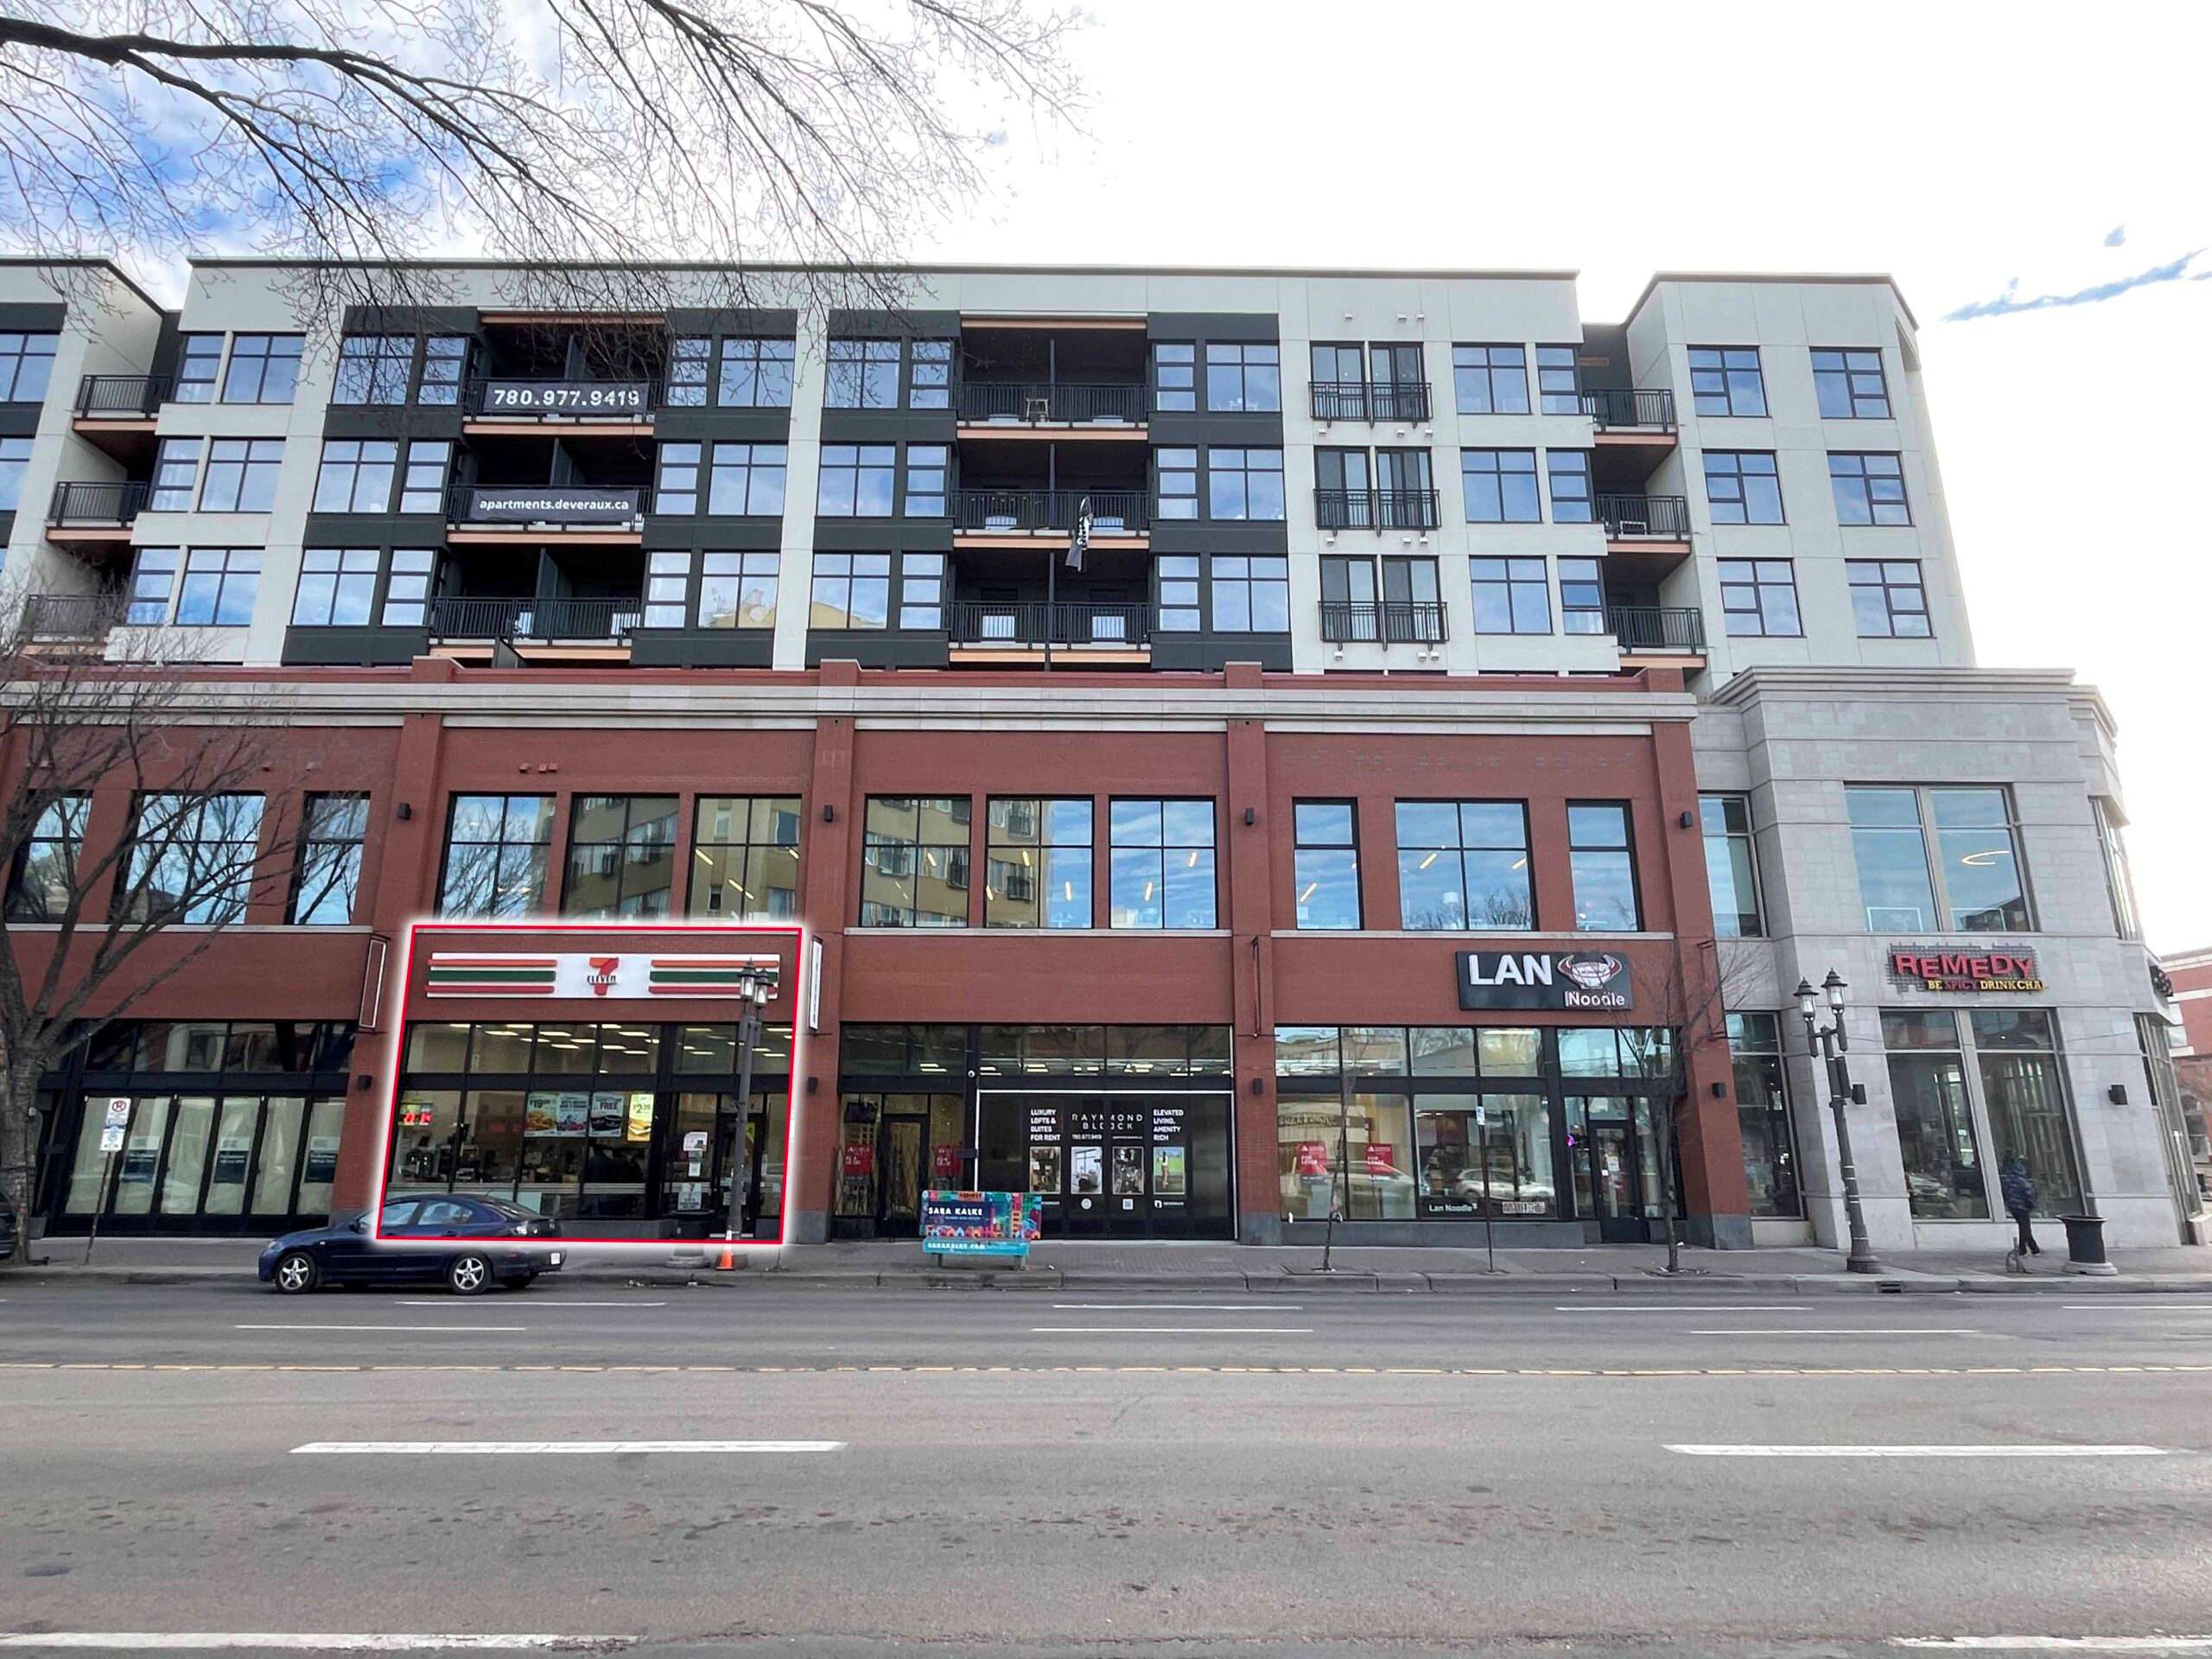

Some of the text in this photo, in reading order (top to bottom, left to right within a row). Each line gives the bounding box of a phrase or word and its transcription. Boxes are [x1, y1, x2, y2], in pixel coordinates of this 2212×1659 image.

[494, 390, 639, 405] 780.977.9419
[480, 499, 629, 512] apartments.deveraux.ca
[1469, 955, 1553, 985] LAN
[1894, 953, 2031, 978] REMEDY
[589, 957, 620, 995] 7
[1928, 980, 1942, 990] BE
[1980, 981, 2017, 990] DRINK
[1565, 991, 1625, 1007] Noodle
[928, 1206, 982, 1216] SARA KALKE
